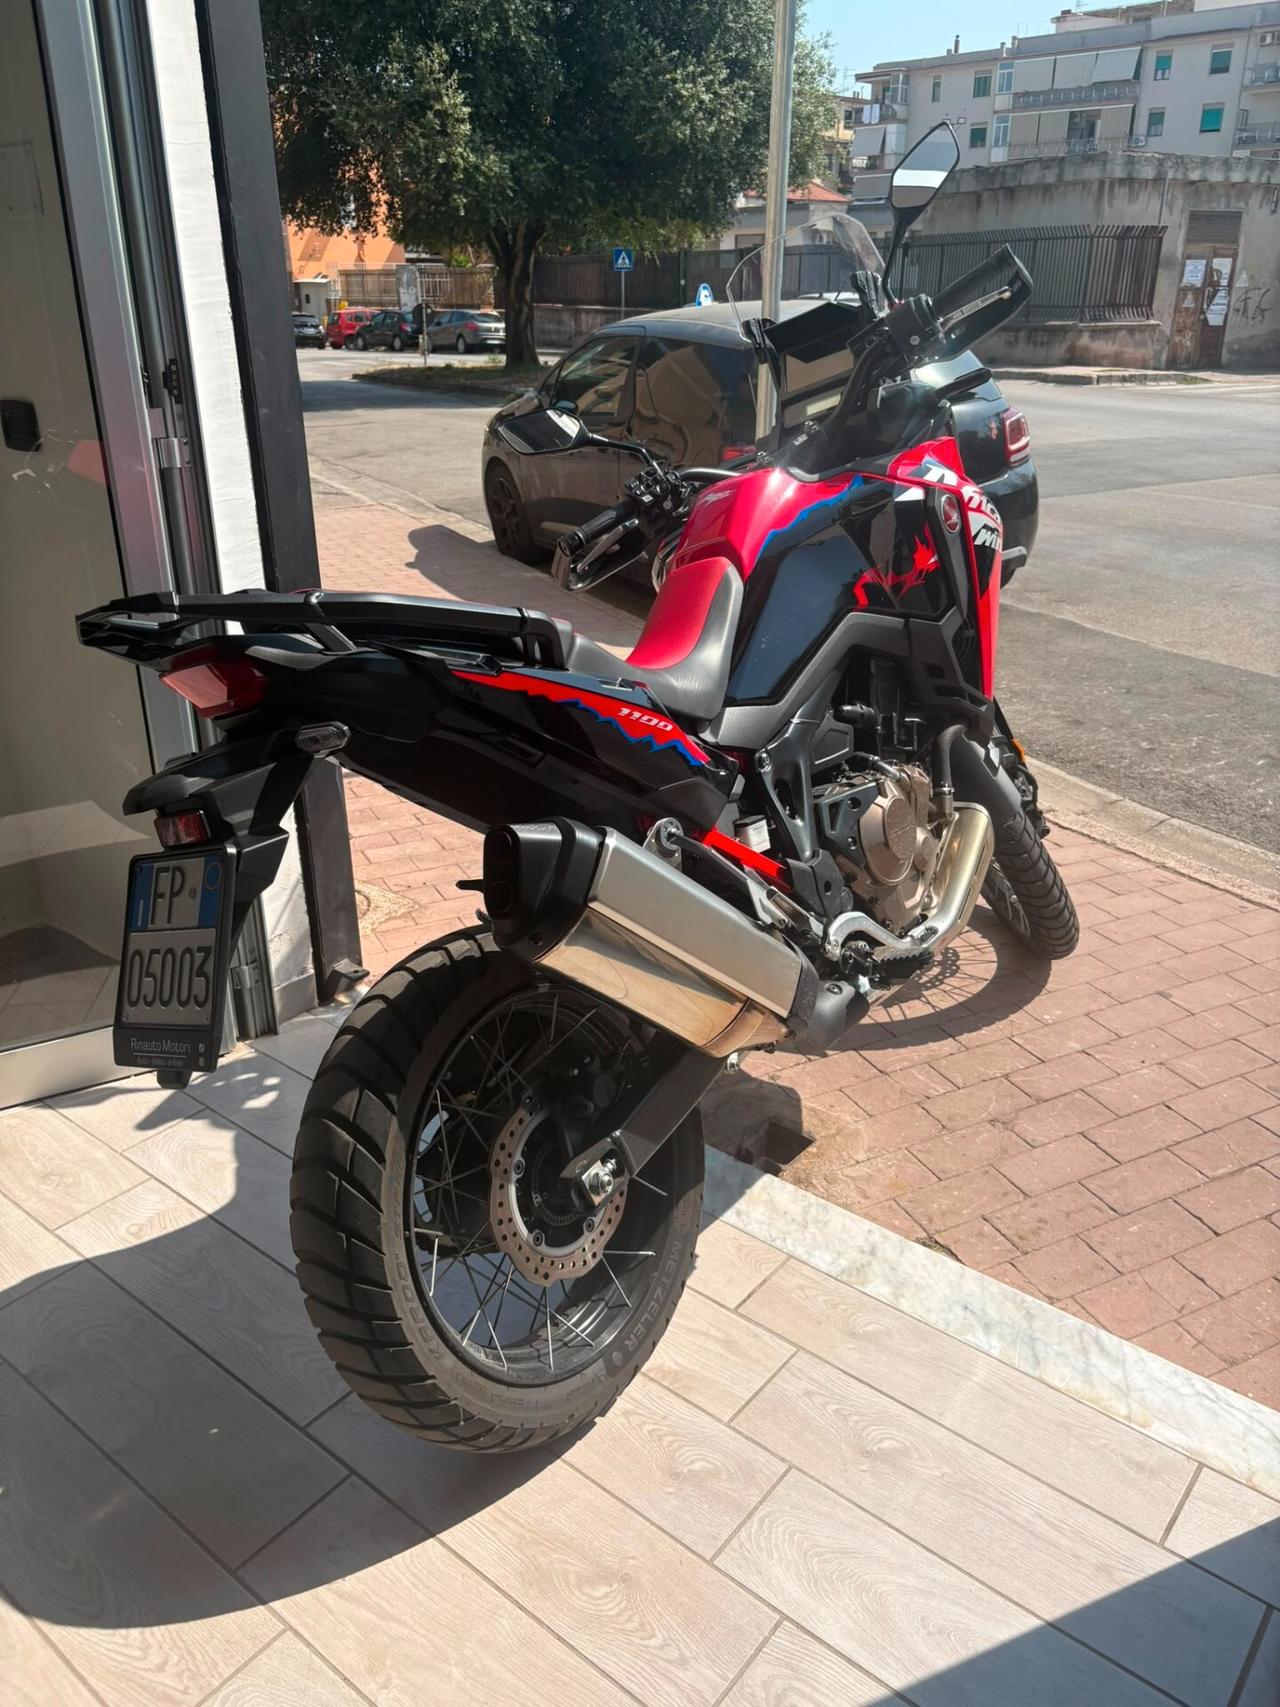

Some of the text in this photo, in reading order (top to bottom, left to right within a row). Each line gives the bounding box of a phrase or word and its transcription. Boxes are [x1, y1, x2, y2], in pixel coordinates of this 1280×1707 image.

[617, 707, 674, 732] 1100
[150, 865, 186, 926] FP
[127, 945, 213, 1009] 05003
[624, 1240, 683, 1351] METZELER
